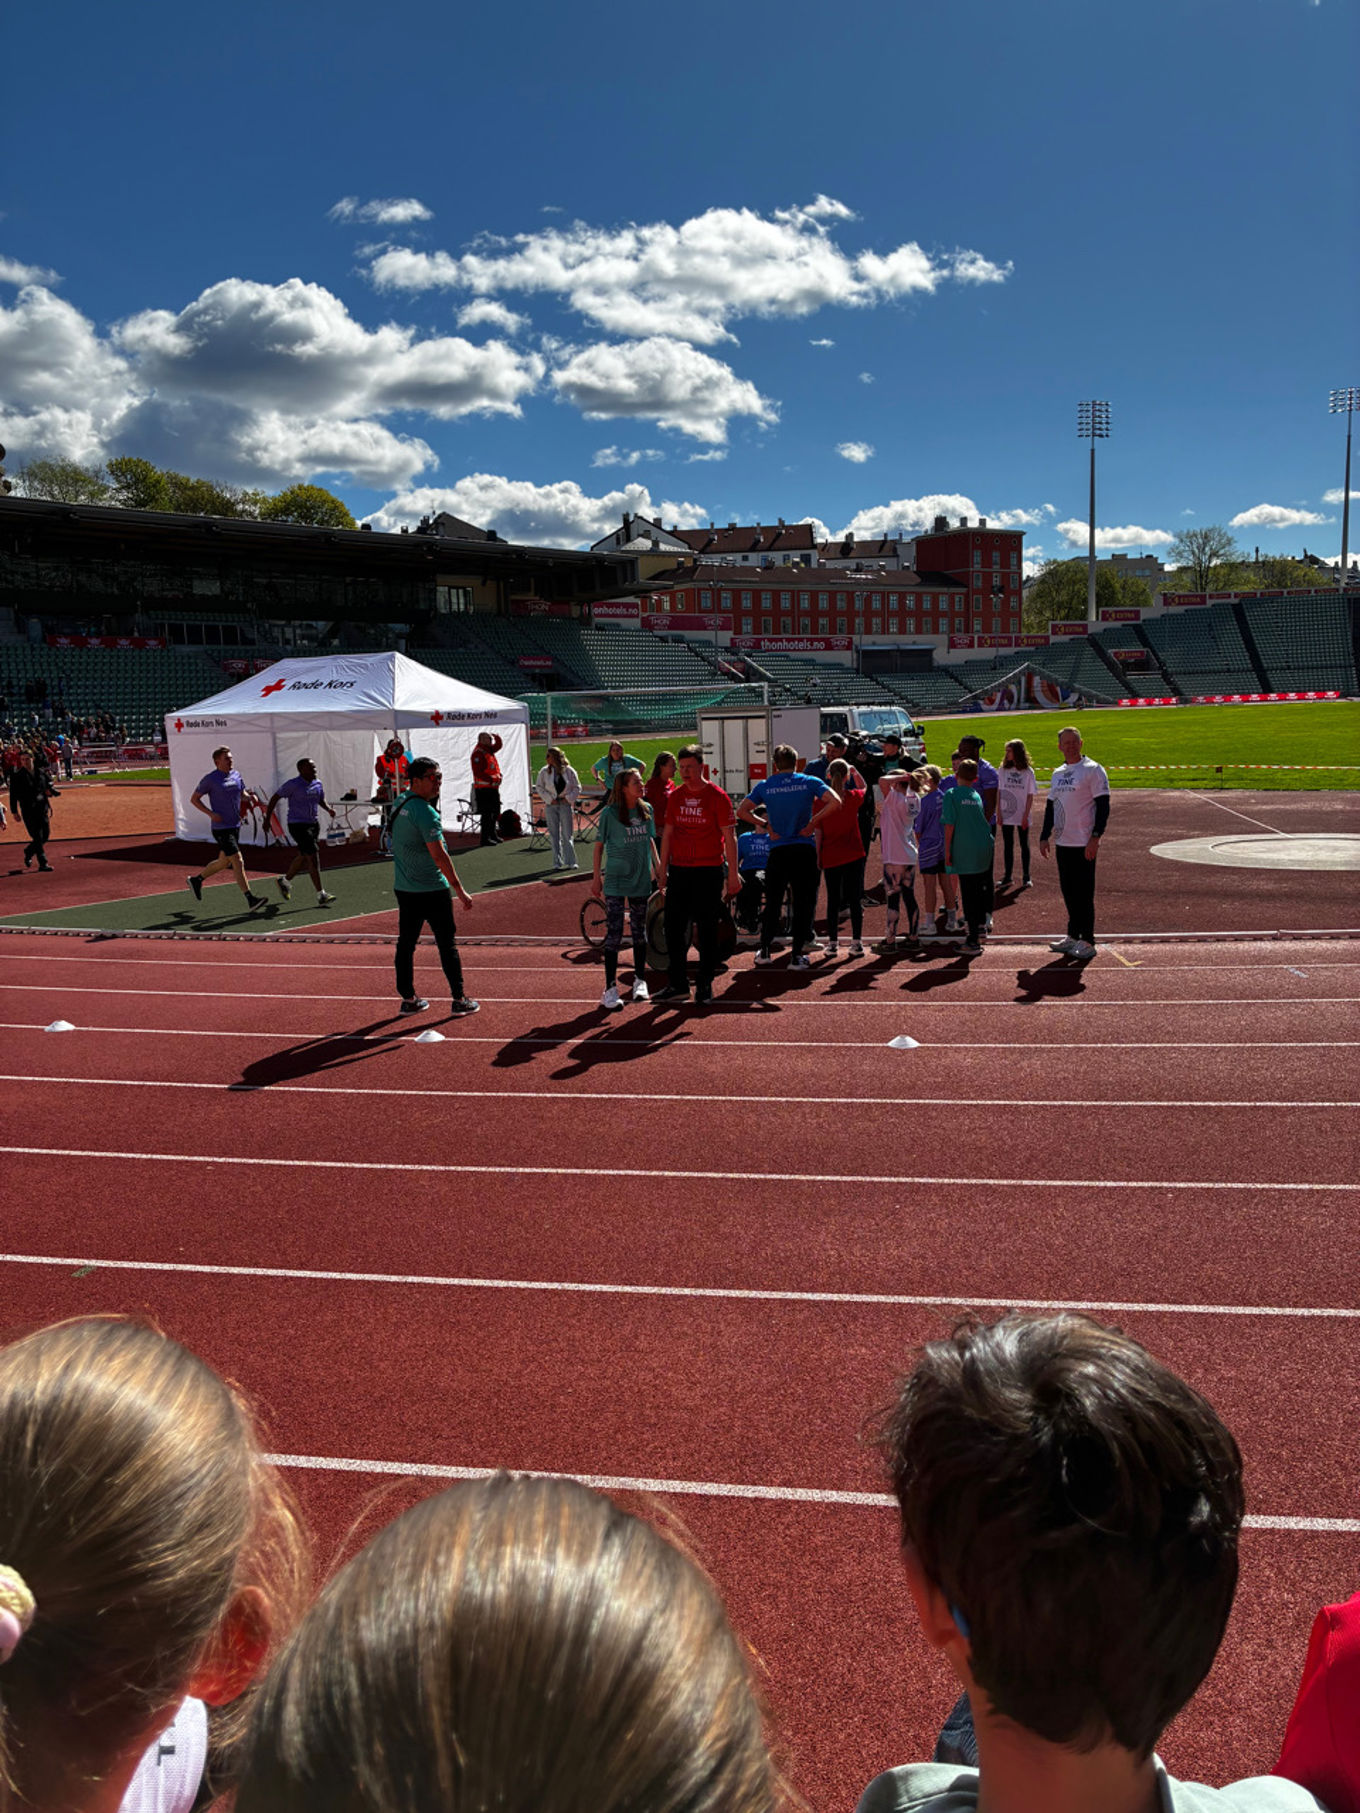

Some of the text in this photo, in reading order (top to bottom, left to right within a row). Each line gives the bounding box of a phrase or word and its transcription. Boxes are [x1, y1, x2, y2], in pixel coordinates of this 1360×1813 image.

[594, 605, 638, 615] onhotels.no
[761, 639, 826, 650] thonhotels.no
[322, 679, 356, 690] Kors
[1057, 778, 1075, 786] TINE
[680, 806, 703, 816] TINE
[625, 825, 648, 836] TINE
